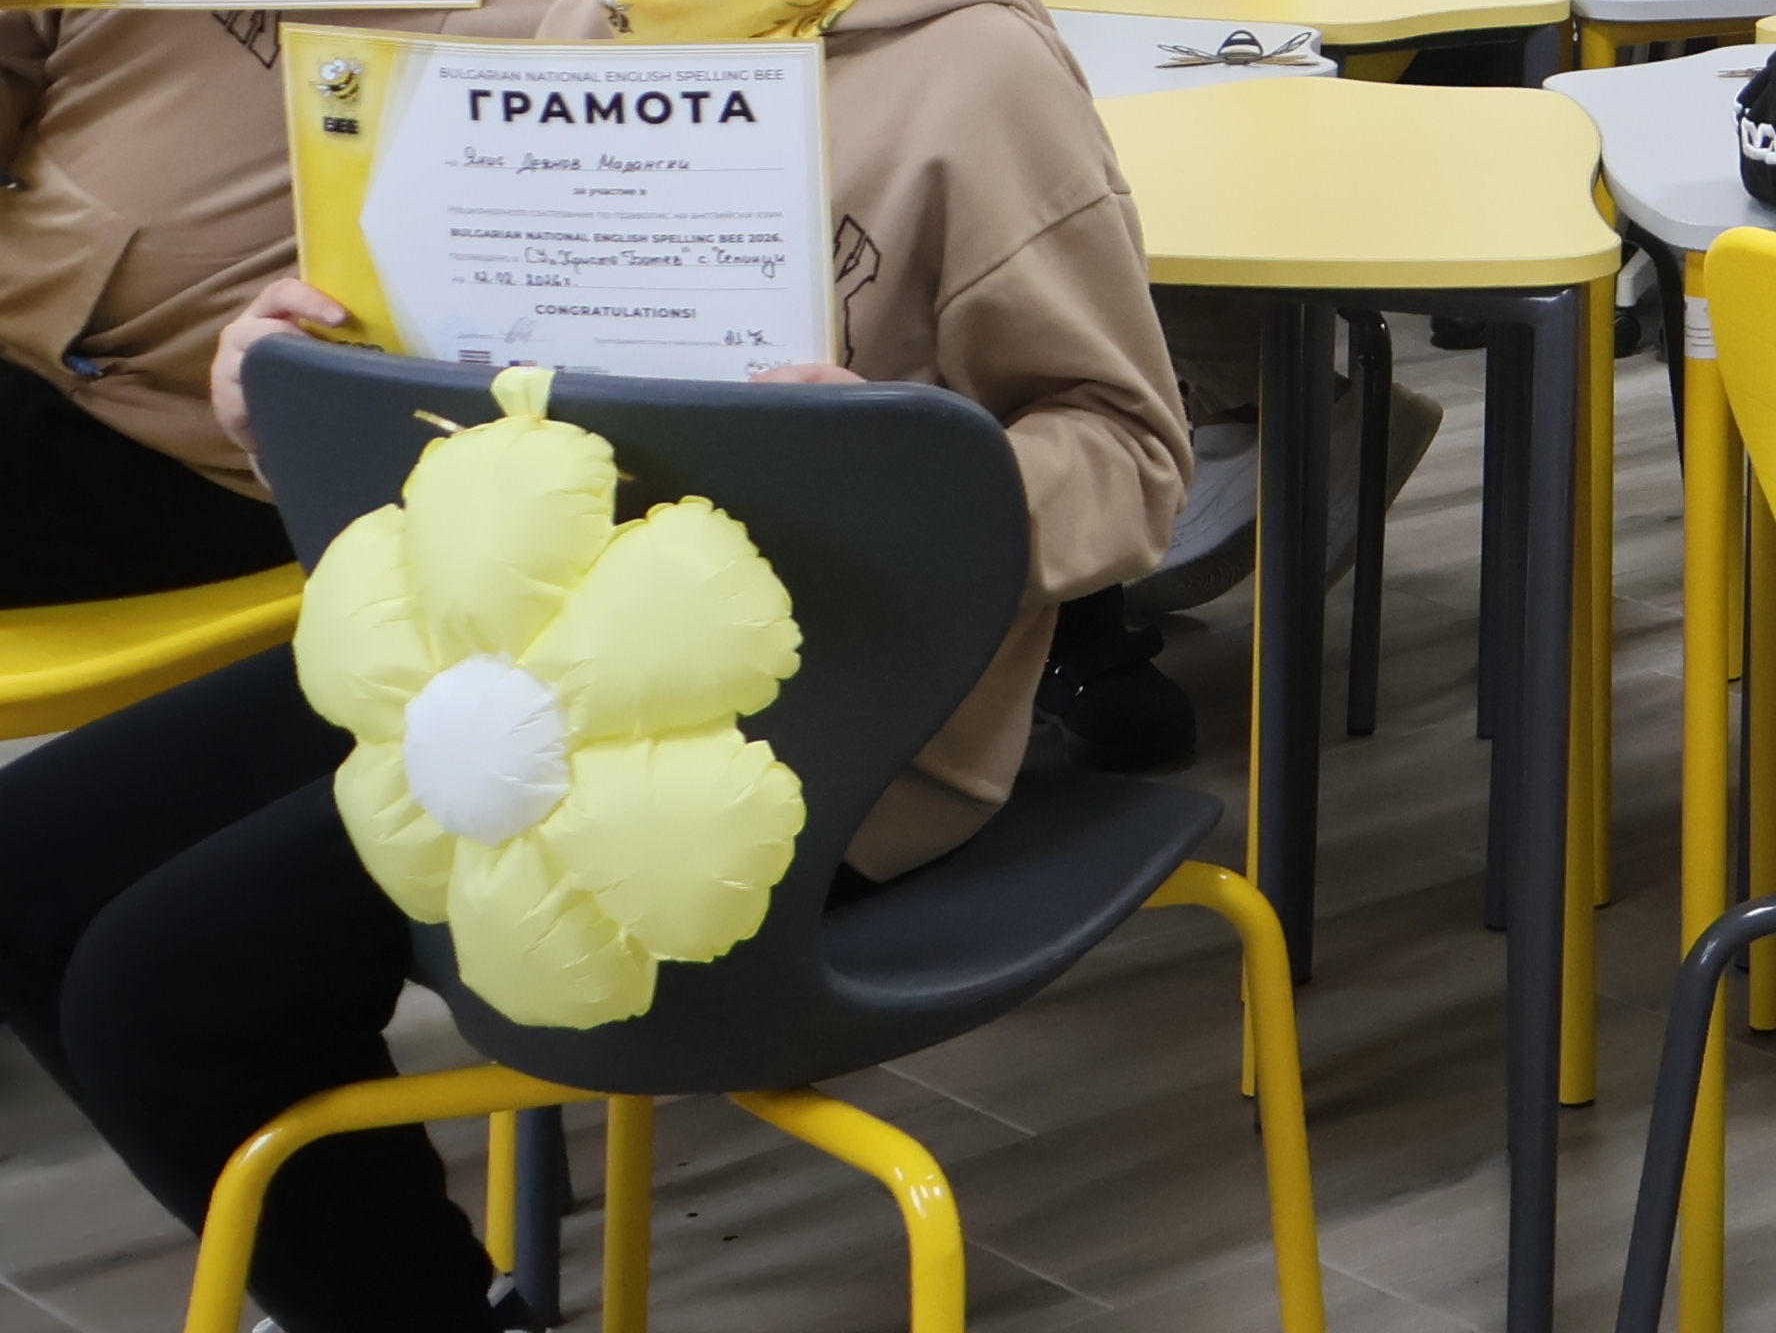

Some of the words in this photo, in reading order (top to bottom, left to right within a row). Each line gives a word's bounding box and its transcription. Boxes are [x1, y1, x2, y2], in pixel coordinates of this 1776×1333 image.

[437, 68, 521, 81] BULGARIAN
[526, 71, 601, 81] NATIONAL
[605, 71, 670, 81] ENGLISH
[675, 70, 749, 81] SPELLING
[754, 70, 784, 81] BEE
[467, 90, 757, 124] ГРАМОТА
[323, 116, 359, 134] BEE
[533, 302, 698, 319] CONGRATULATIONS!
